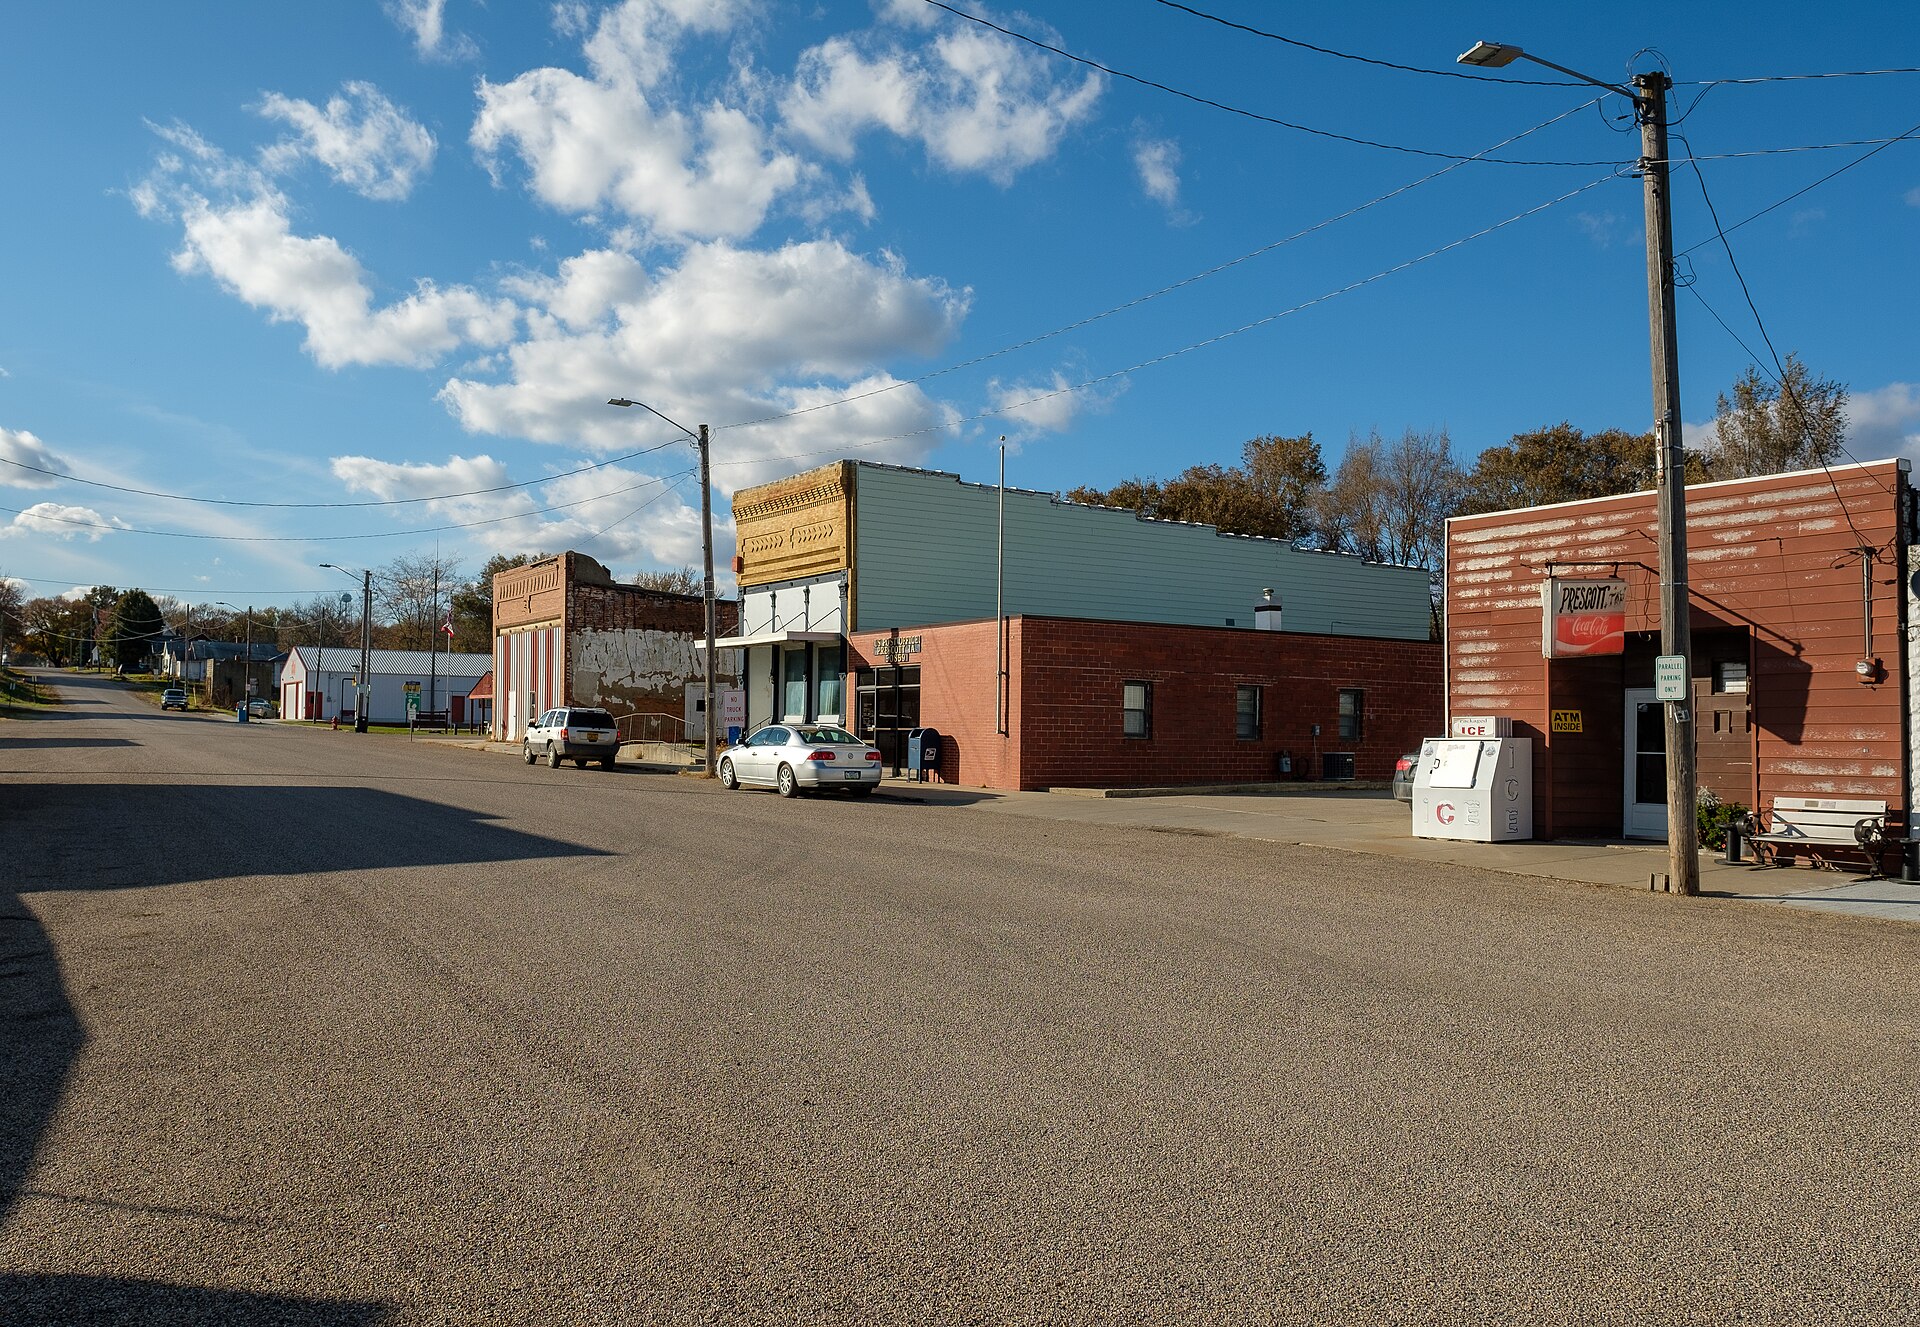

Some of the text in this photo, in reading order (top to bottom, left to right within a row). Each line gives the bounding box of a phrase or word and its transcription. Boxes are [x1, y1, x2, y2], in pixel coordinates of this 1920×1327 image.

[1572, 615, 1609, 637] Coca-Cola
[899, 636, 919, 645] OFFICE
[1554, 712, 1580, 722] ATM
[1461, 726, 1486, 736] ICE
[1554, 723, 1581, 731] INSIDE
